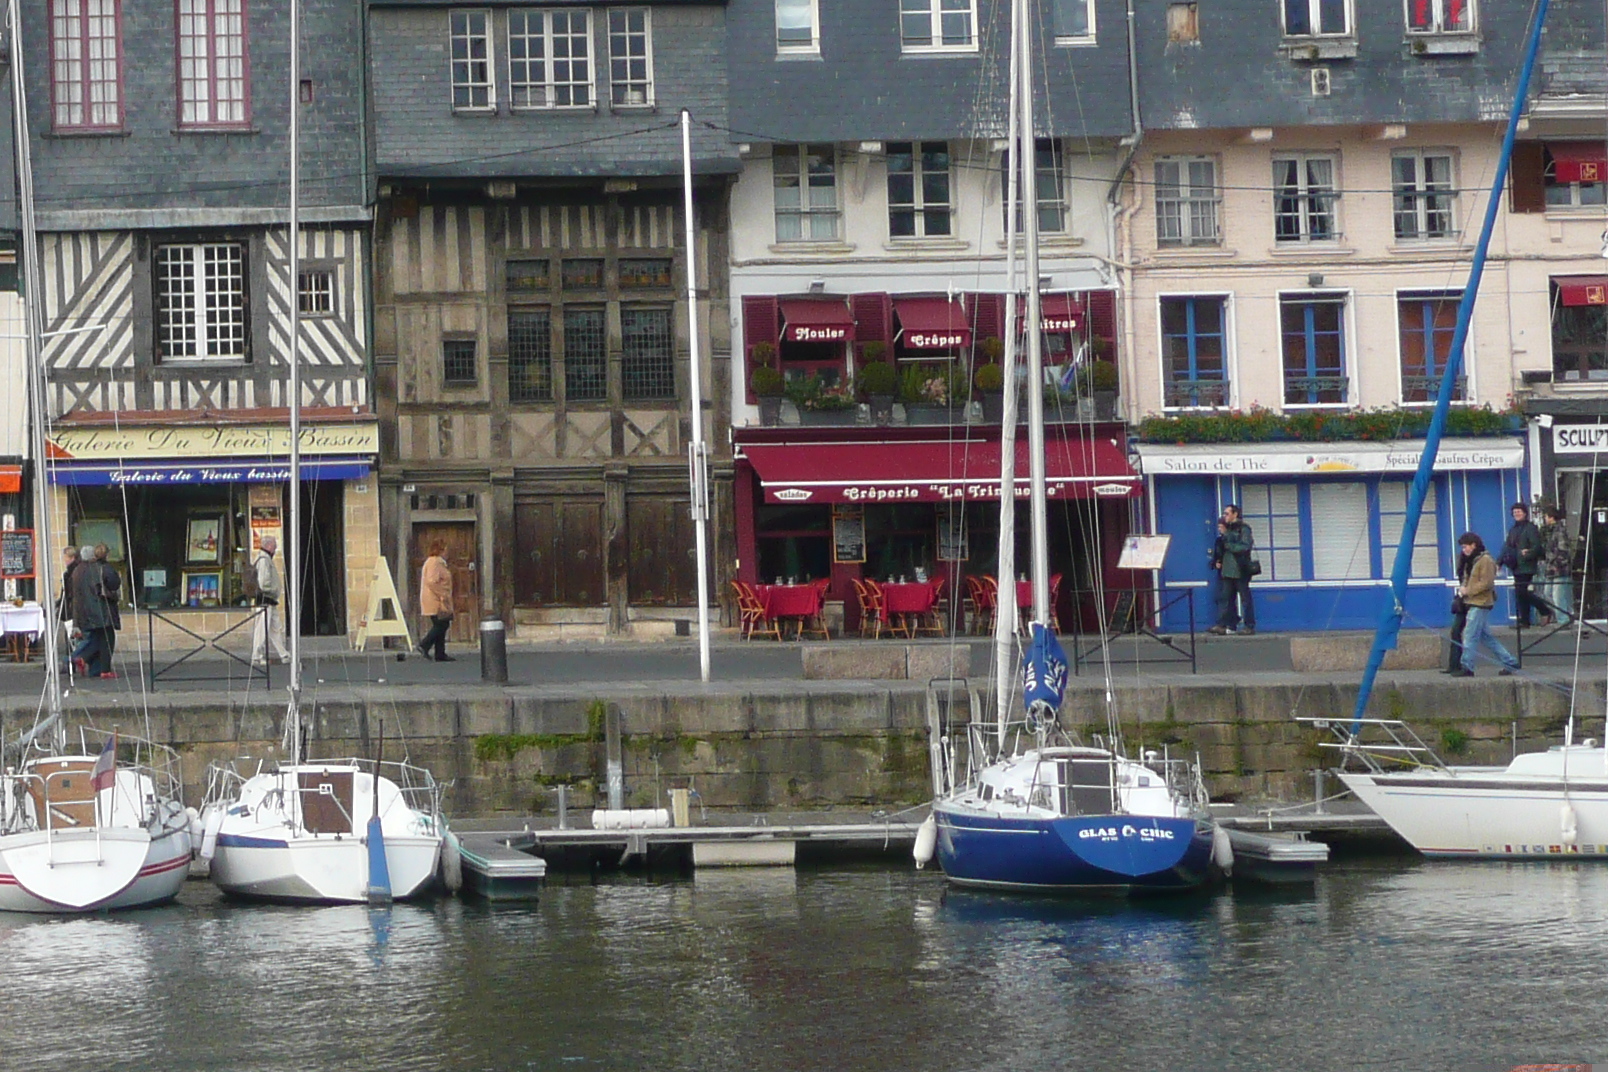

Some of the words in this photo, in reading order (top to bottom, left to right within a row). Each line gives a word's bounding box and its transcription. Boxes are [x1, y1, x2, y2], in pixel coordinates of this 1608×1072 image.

[795, 327, 845, 340] Moules
[910, 332, 963, 346] Crêpes
[52, 429, 134, 454] Galerie
[144, 427, 191, 450] Du
[202, 427, 270, 450] Vieux
[286, 428, 371, 448] Bassin
[1164, 458, 1208, 470] Salon
[1213, 458, 1233, 470] de
[1237, 458, 1268, 470] Thé
[1386, 453, 1422, 465] Spécial
[1472, 452, 1504, 465] Crêpes
[109, 470, 167, 482] Galerie
[170, 469, 193, 481] du
[200, 468, 242, 480] Vieux
[843, 485, 919, 500] Crêperie
[969, 482, 1064, 498] Trinuee"
[1079, 827, 1117, 838] GLAS
[1140, 827, 1174, 839] CHIC
